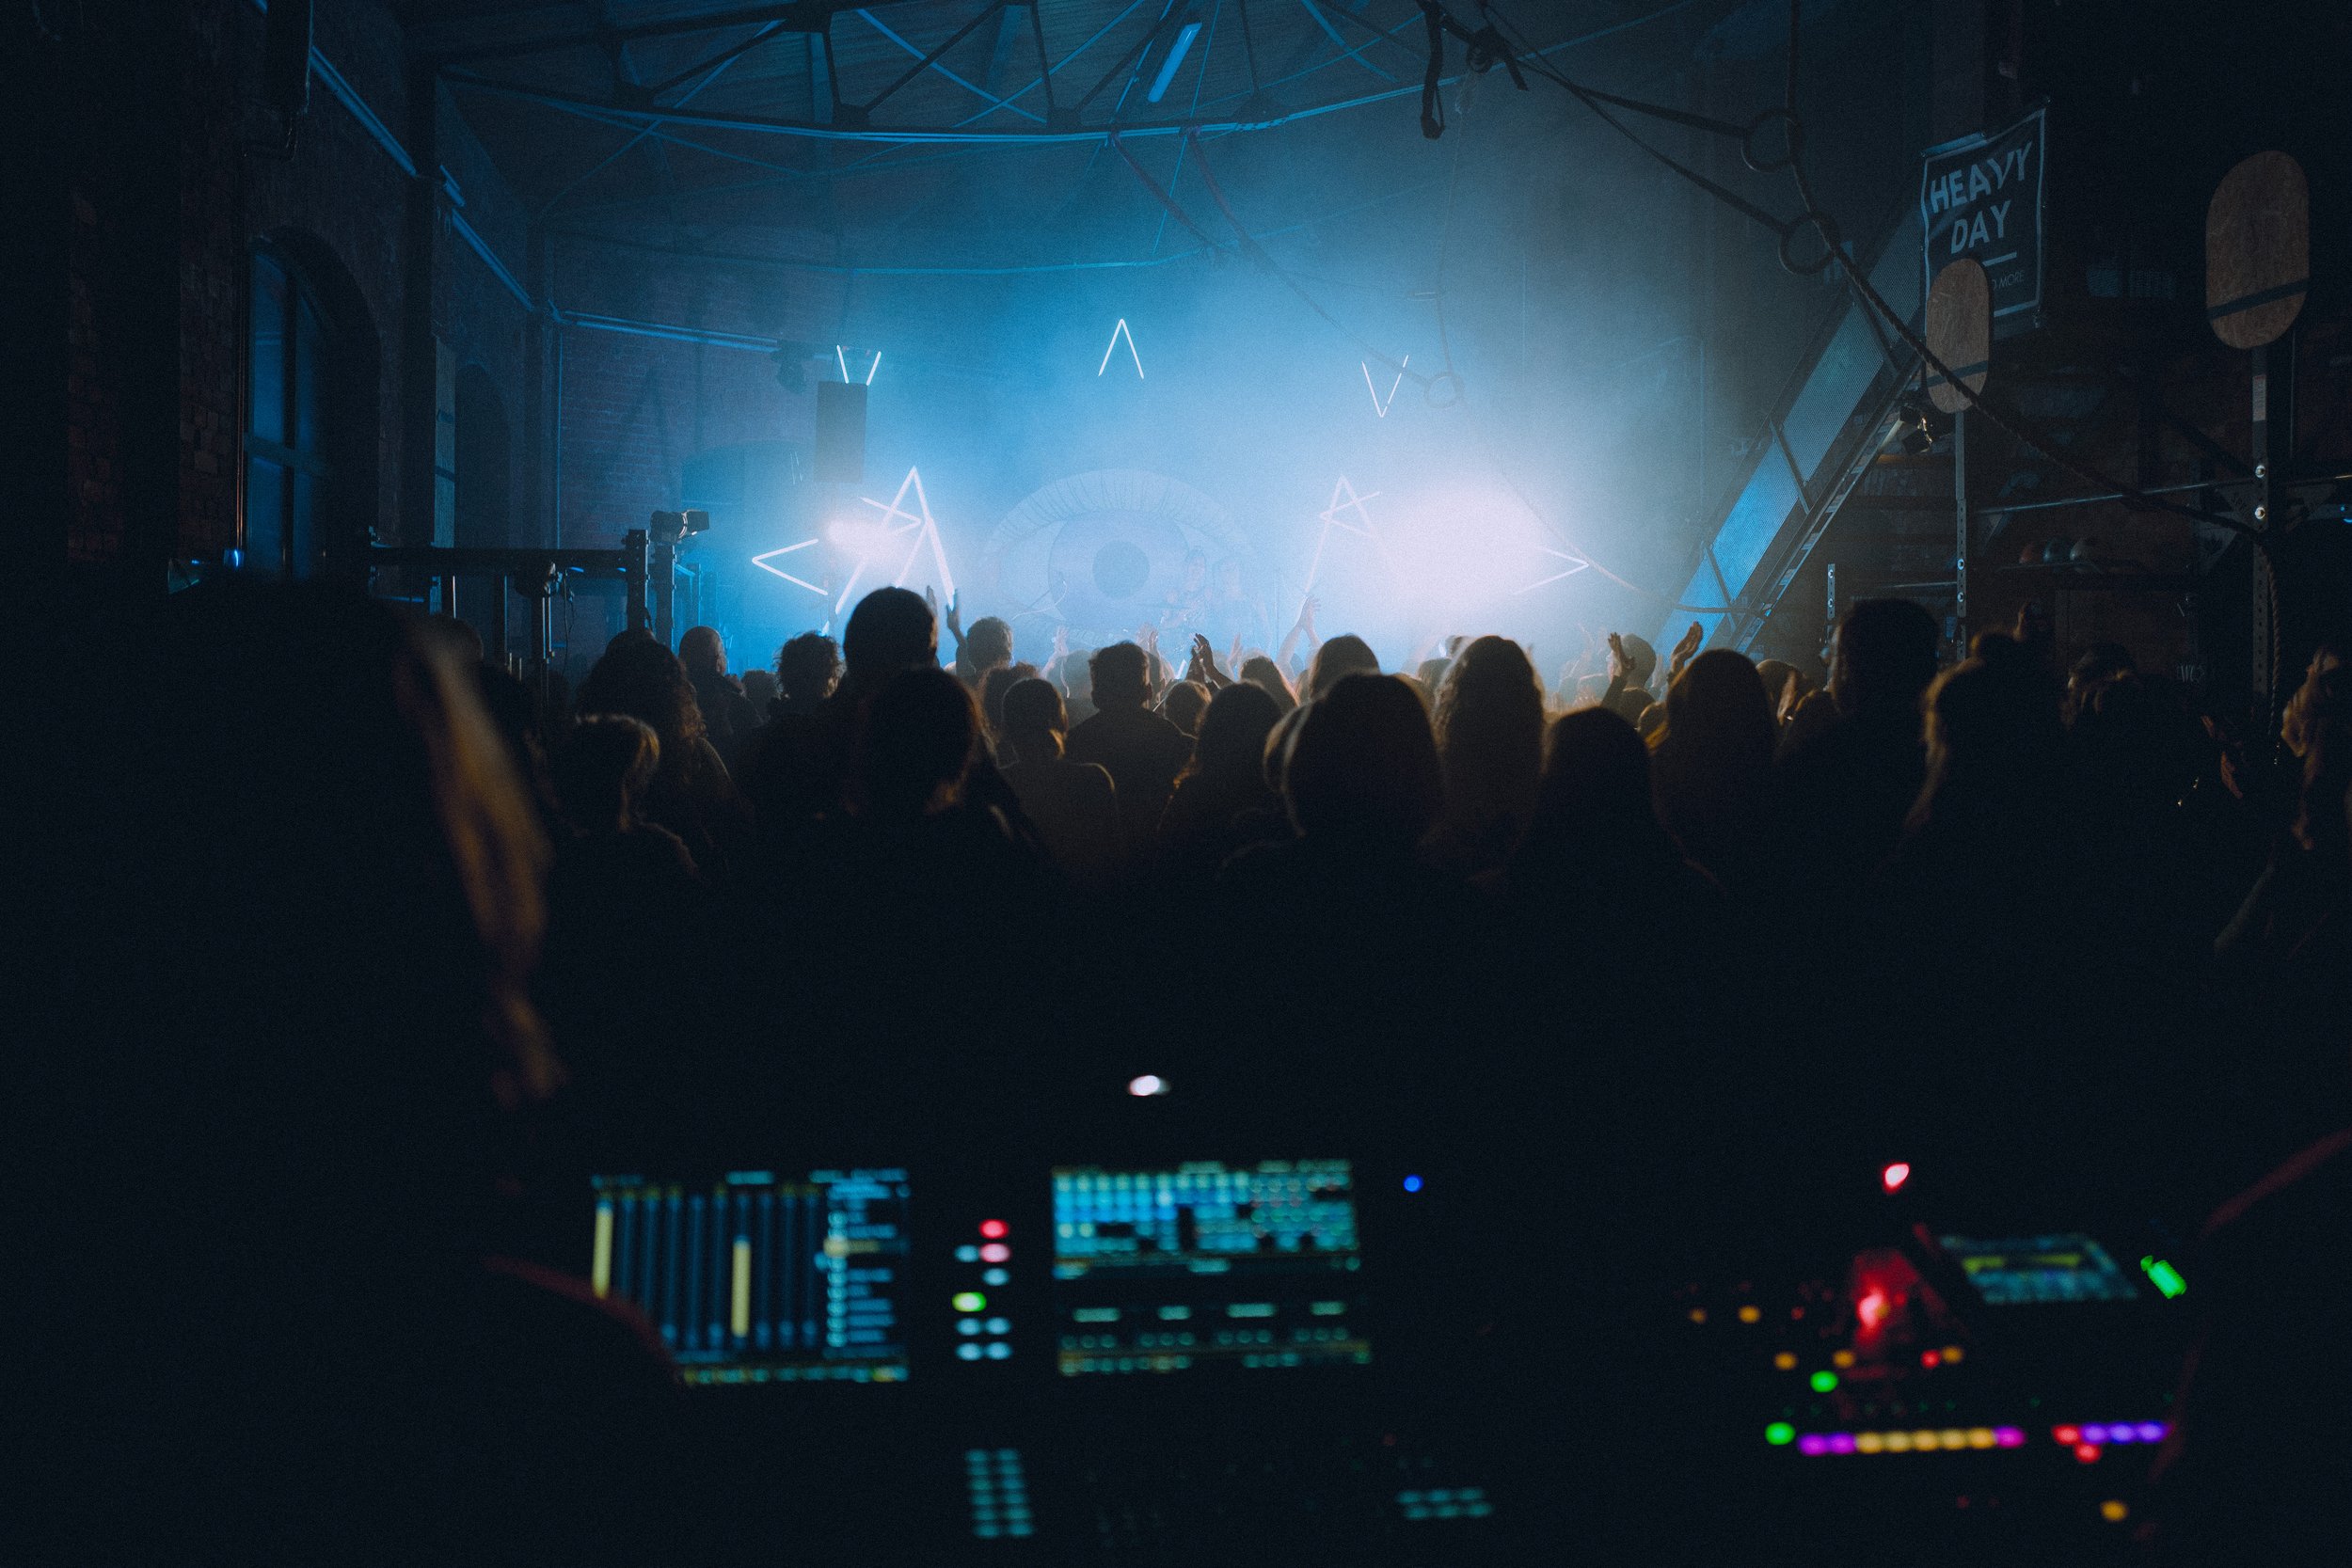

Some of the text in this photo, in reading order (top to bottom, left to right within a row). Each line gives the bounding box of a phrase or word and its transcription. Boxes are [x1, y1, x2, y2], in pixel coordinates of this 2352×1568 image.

[1931, 141, 2032, 214] HEAVY
[1951, 200, 2011, 254] DAY
[1997, 271, 2025, 289] MORE
